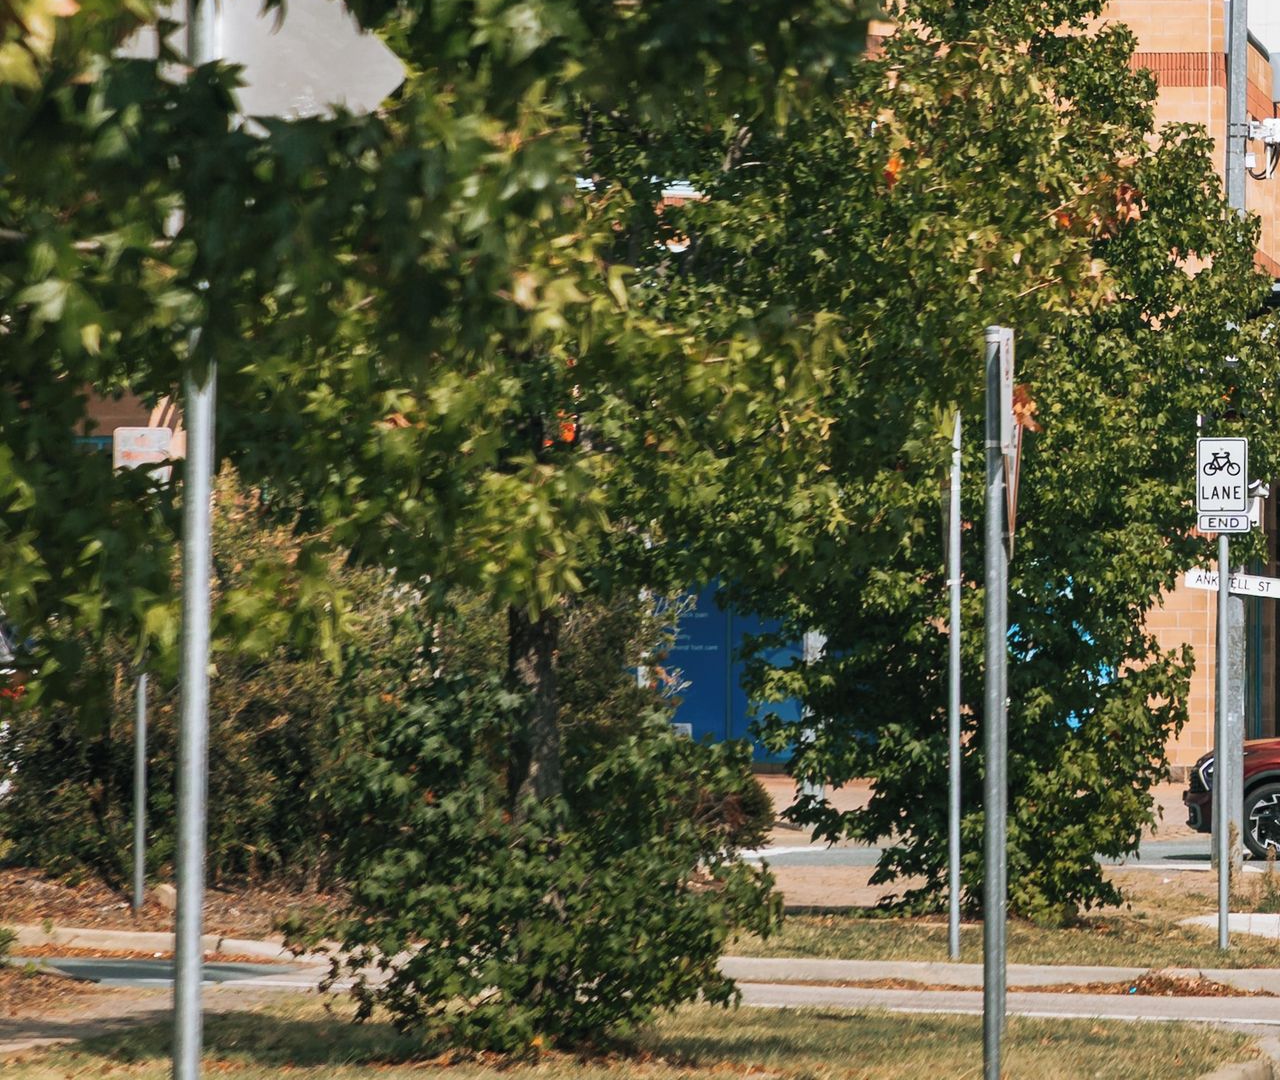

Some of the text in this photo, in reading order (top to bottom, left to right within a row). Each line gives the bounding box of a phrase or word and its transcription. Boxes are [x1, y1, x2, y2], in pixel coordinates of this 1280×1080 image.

[1202, 485, 1242, 500] LANE
[1208, 517, 1240, 528] END
[1195, 575, 1272, 593] ANKELL ST
